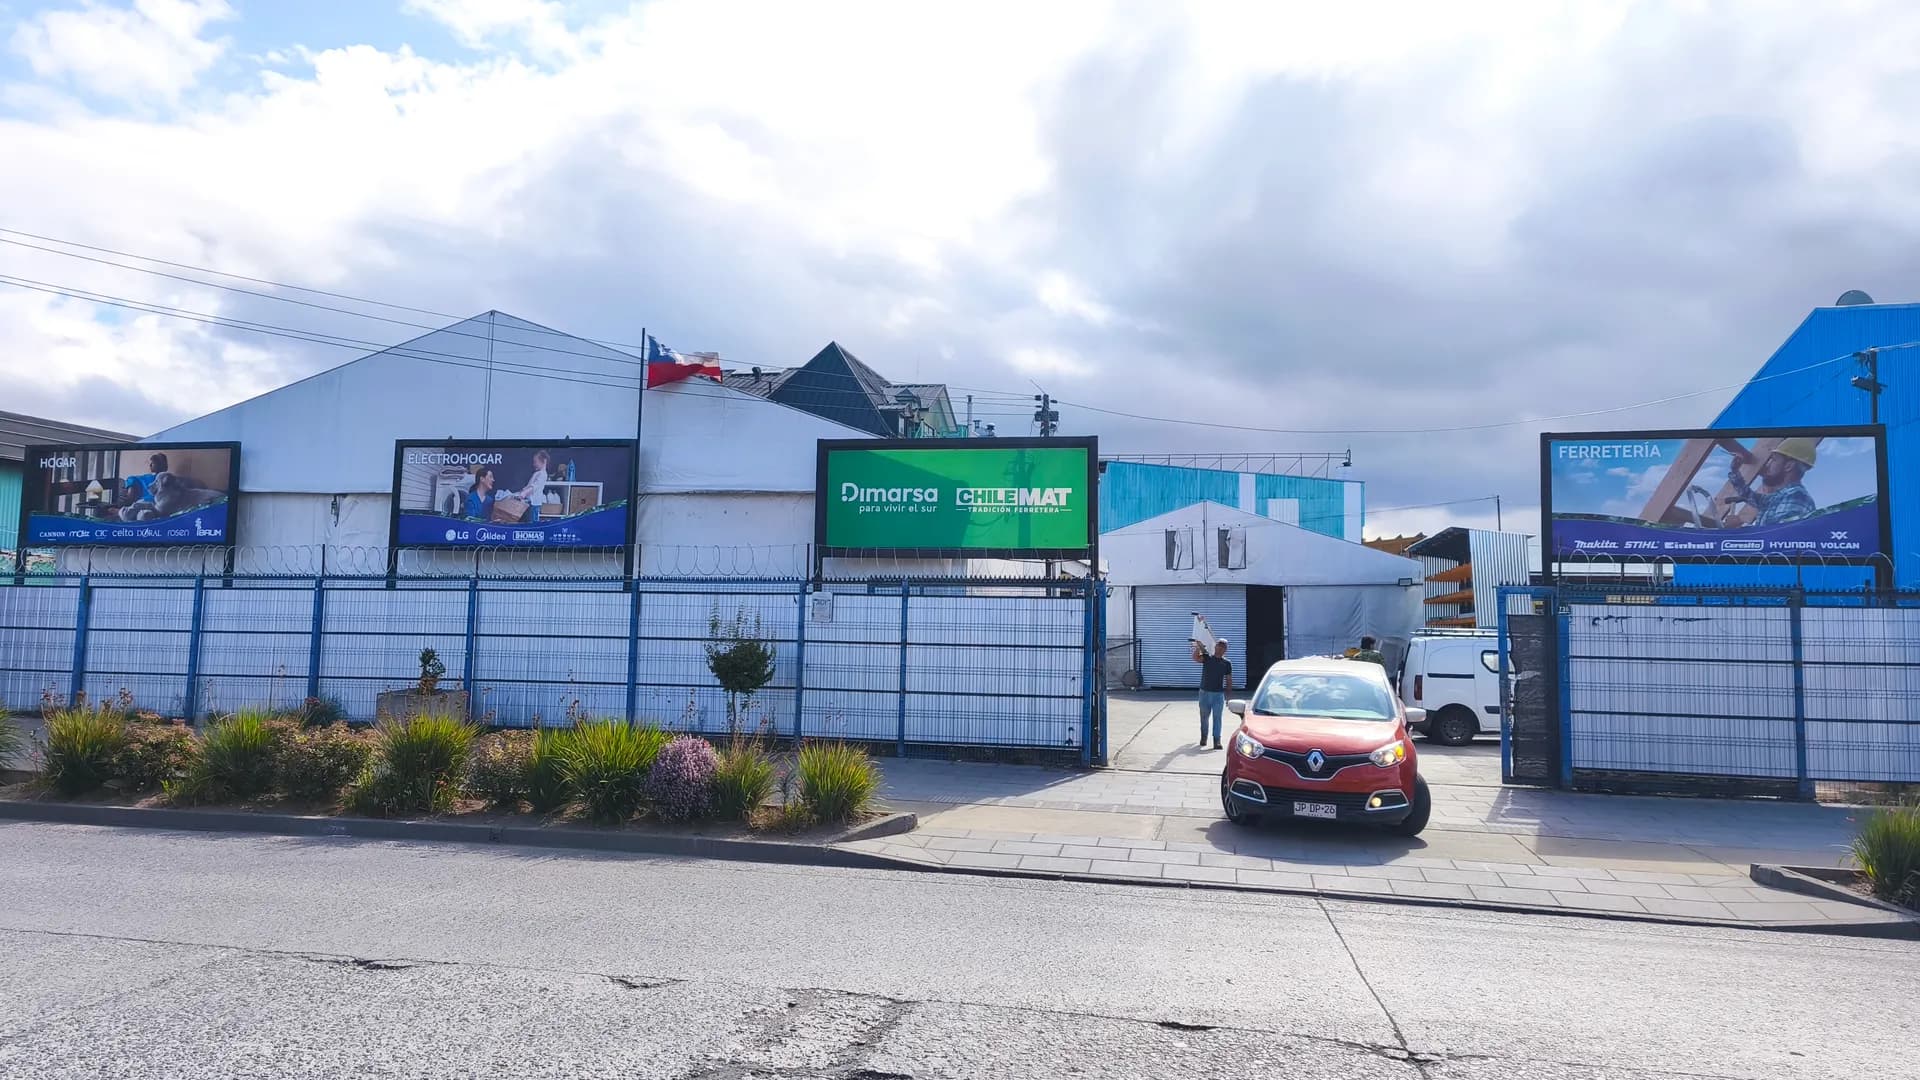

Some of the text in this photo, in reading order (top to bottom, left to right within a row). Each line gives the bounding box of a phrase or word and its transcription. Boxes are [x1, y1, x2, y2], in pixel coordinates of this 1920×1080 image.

[1559, 442, 1661, 459] FERRETERÍA
[40, 457, 76, 468] HOGAR
[408, 453, 502, 464] ELECTROHOGAR
[956, 488, 1072, 506] CHILEMAT
[859, 503, 937, 514] para vivir el sur
[457, 532, 469, 540] LG
[1624, 540, 1658, 549] STIHL
[1664, 541, 1715, 549] Einhell
[1769, 541, 1816, 549] HYUNDAI
